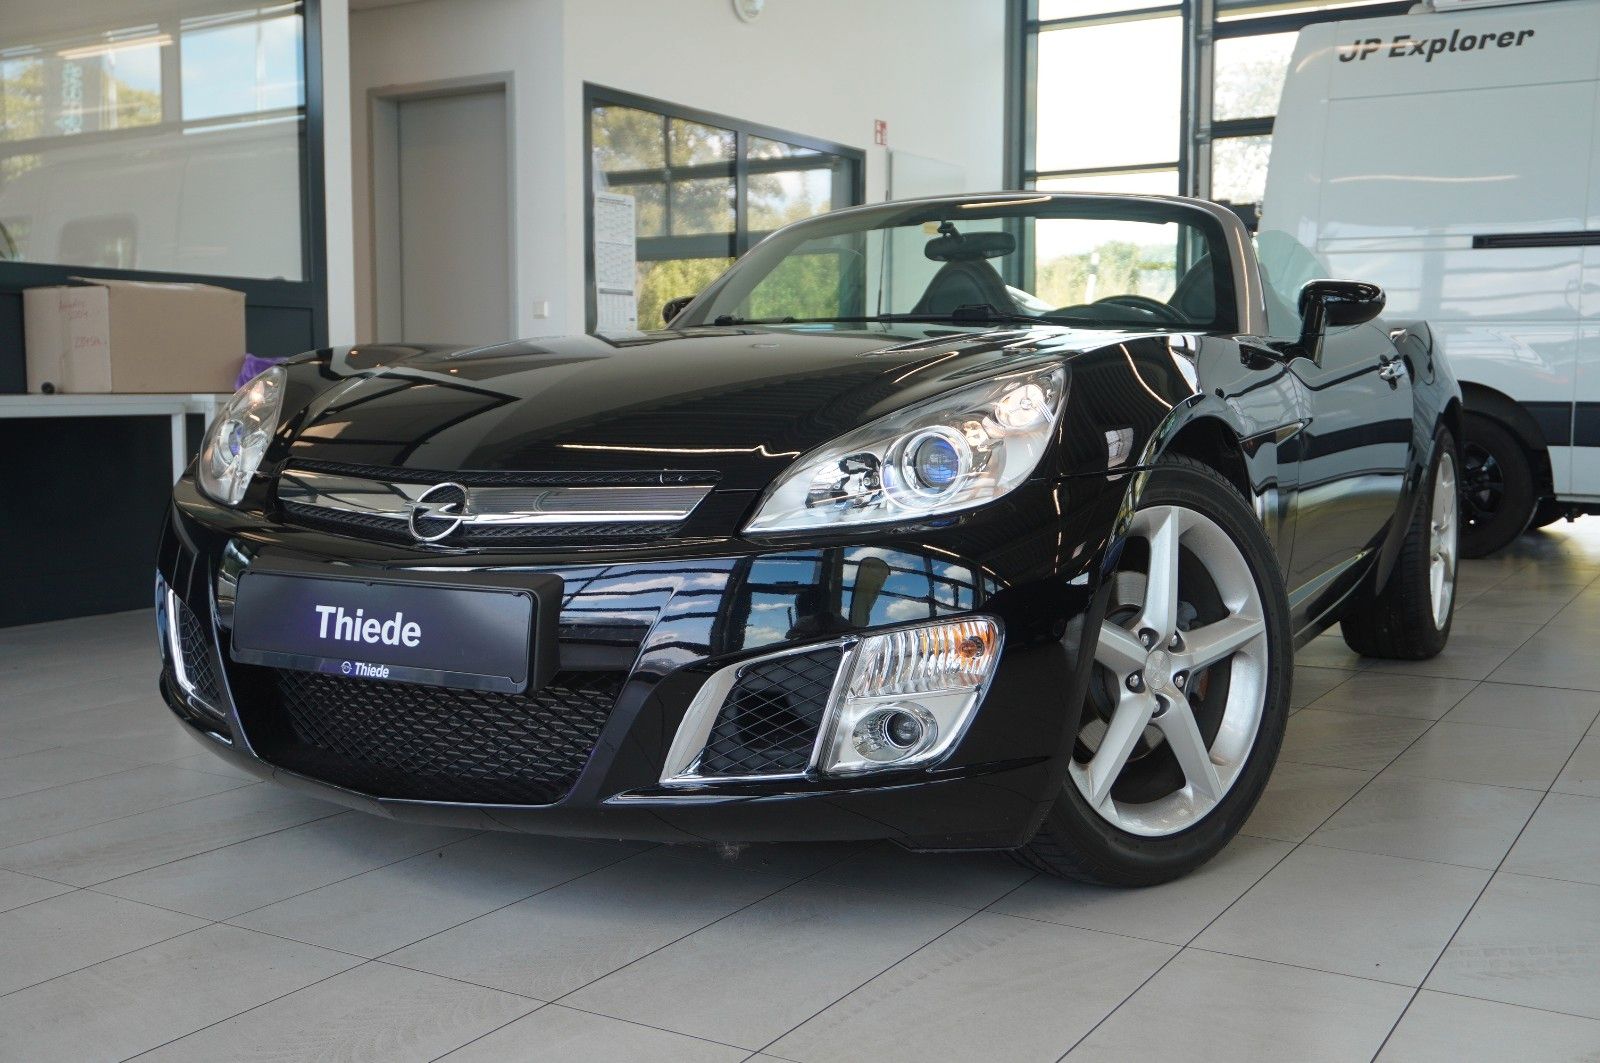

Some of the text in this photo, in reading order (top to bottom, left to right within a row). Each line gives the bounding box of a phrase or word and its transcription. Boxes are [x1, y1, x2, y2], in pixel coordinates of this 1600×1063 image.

[1339, 29, 1535, 62] JP Explorer
[315, 605, 422, 647] Thiede
[355, 662, 389, 678] Thiede
